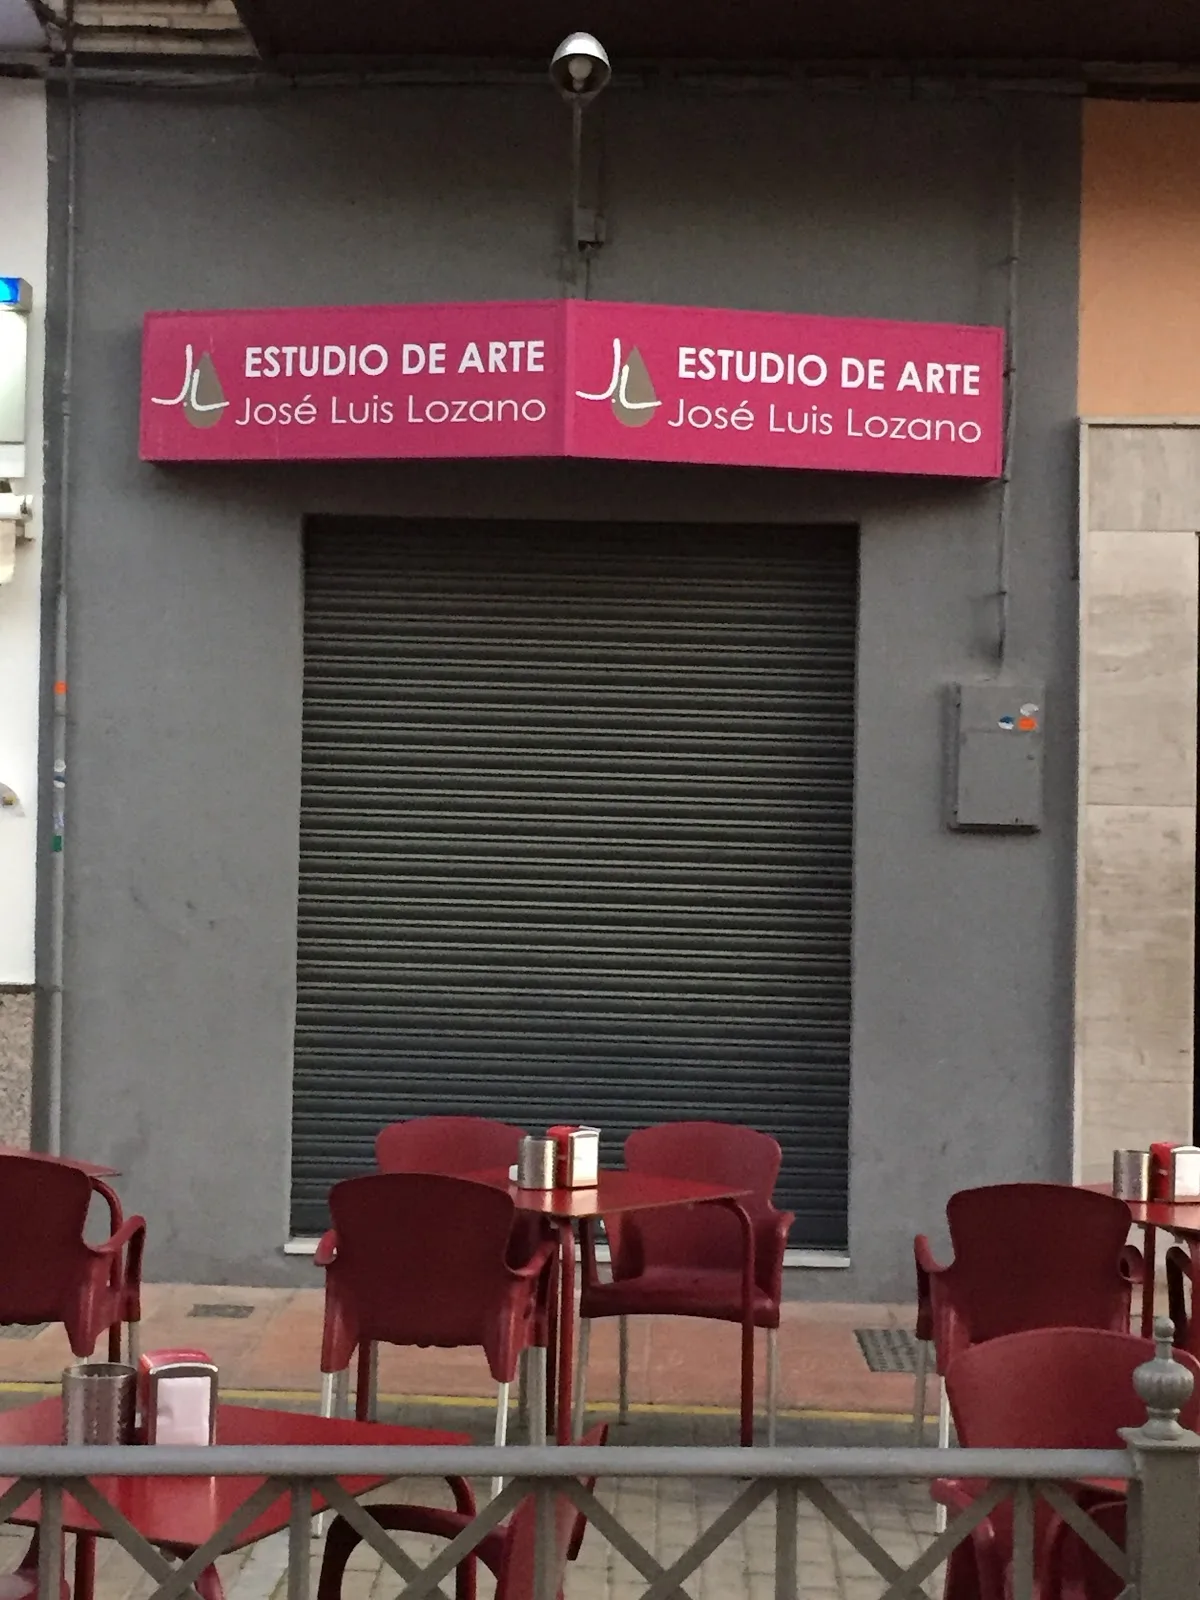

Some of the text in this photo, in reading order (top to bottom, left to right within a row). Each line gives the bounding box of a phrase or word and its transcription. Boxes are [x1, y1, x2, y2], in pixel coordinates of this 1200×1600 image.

[245, 340, 545, 378] ESTUDIO DE ARTE
[678, 346, 981, 396] ESTUDIO DE ARTE
[235, 394, 547, 426] José Luis Lozano
[667, 397, 982, 444] José Luis Lozano
